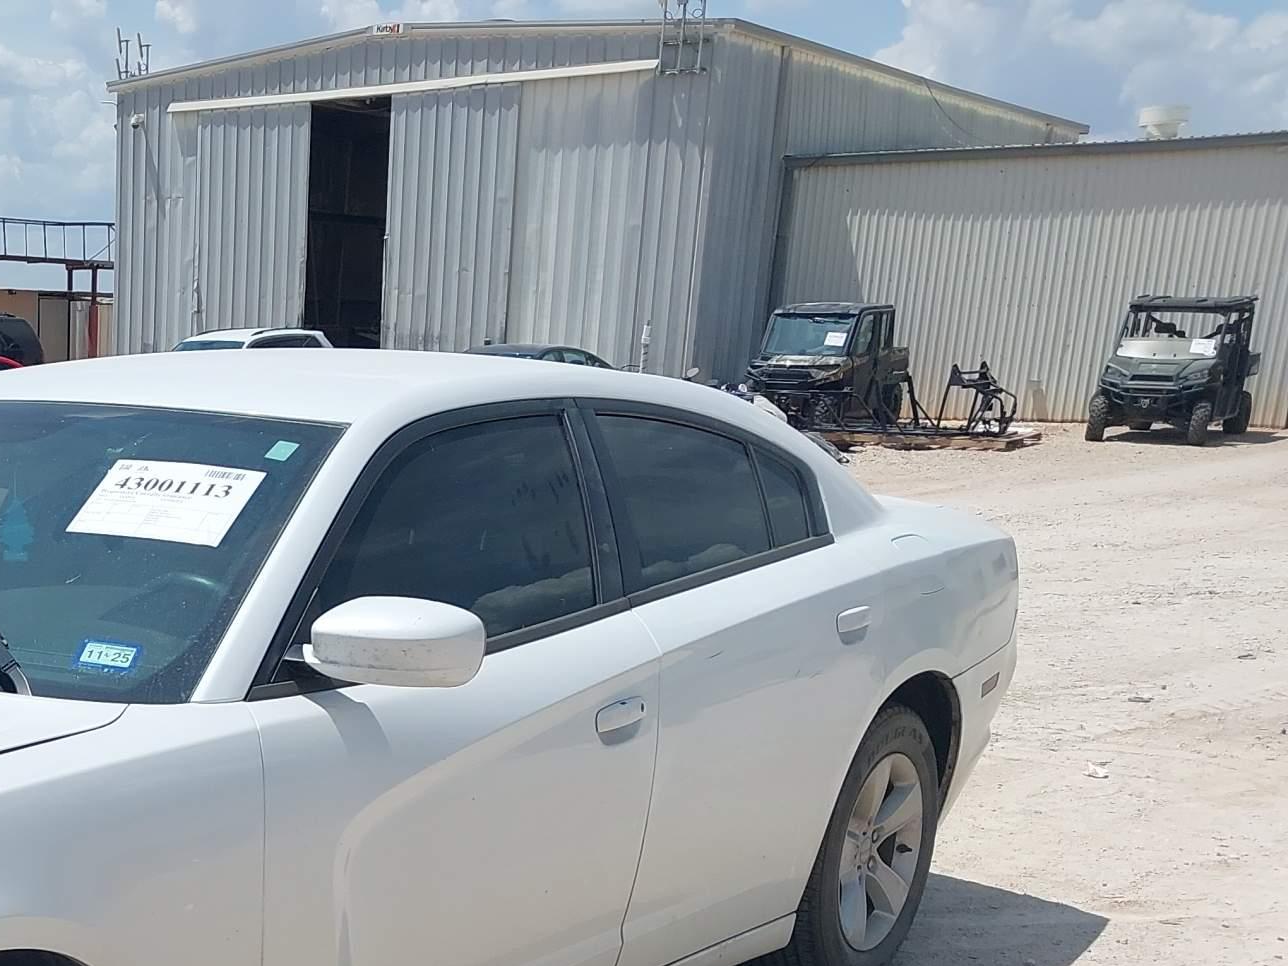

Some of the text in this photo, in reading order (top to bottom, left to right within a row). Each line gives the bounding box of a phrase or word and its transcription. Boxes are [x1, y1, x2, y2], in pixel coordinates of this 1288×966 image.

[114, 475, 233, 498] 43001113
[87, 650, 131, 664] 11 25
